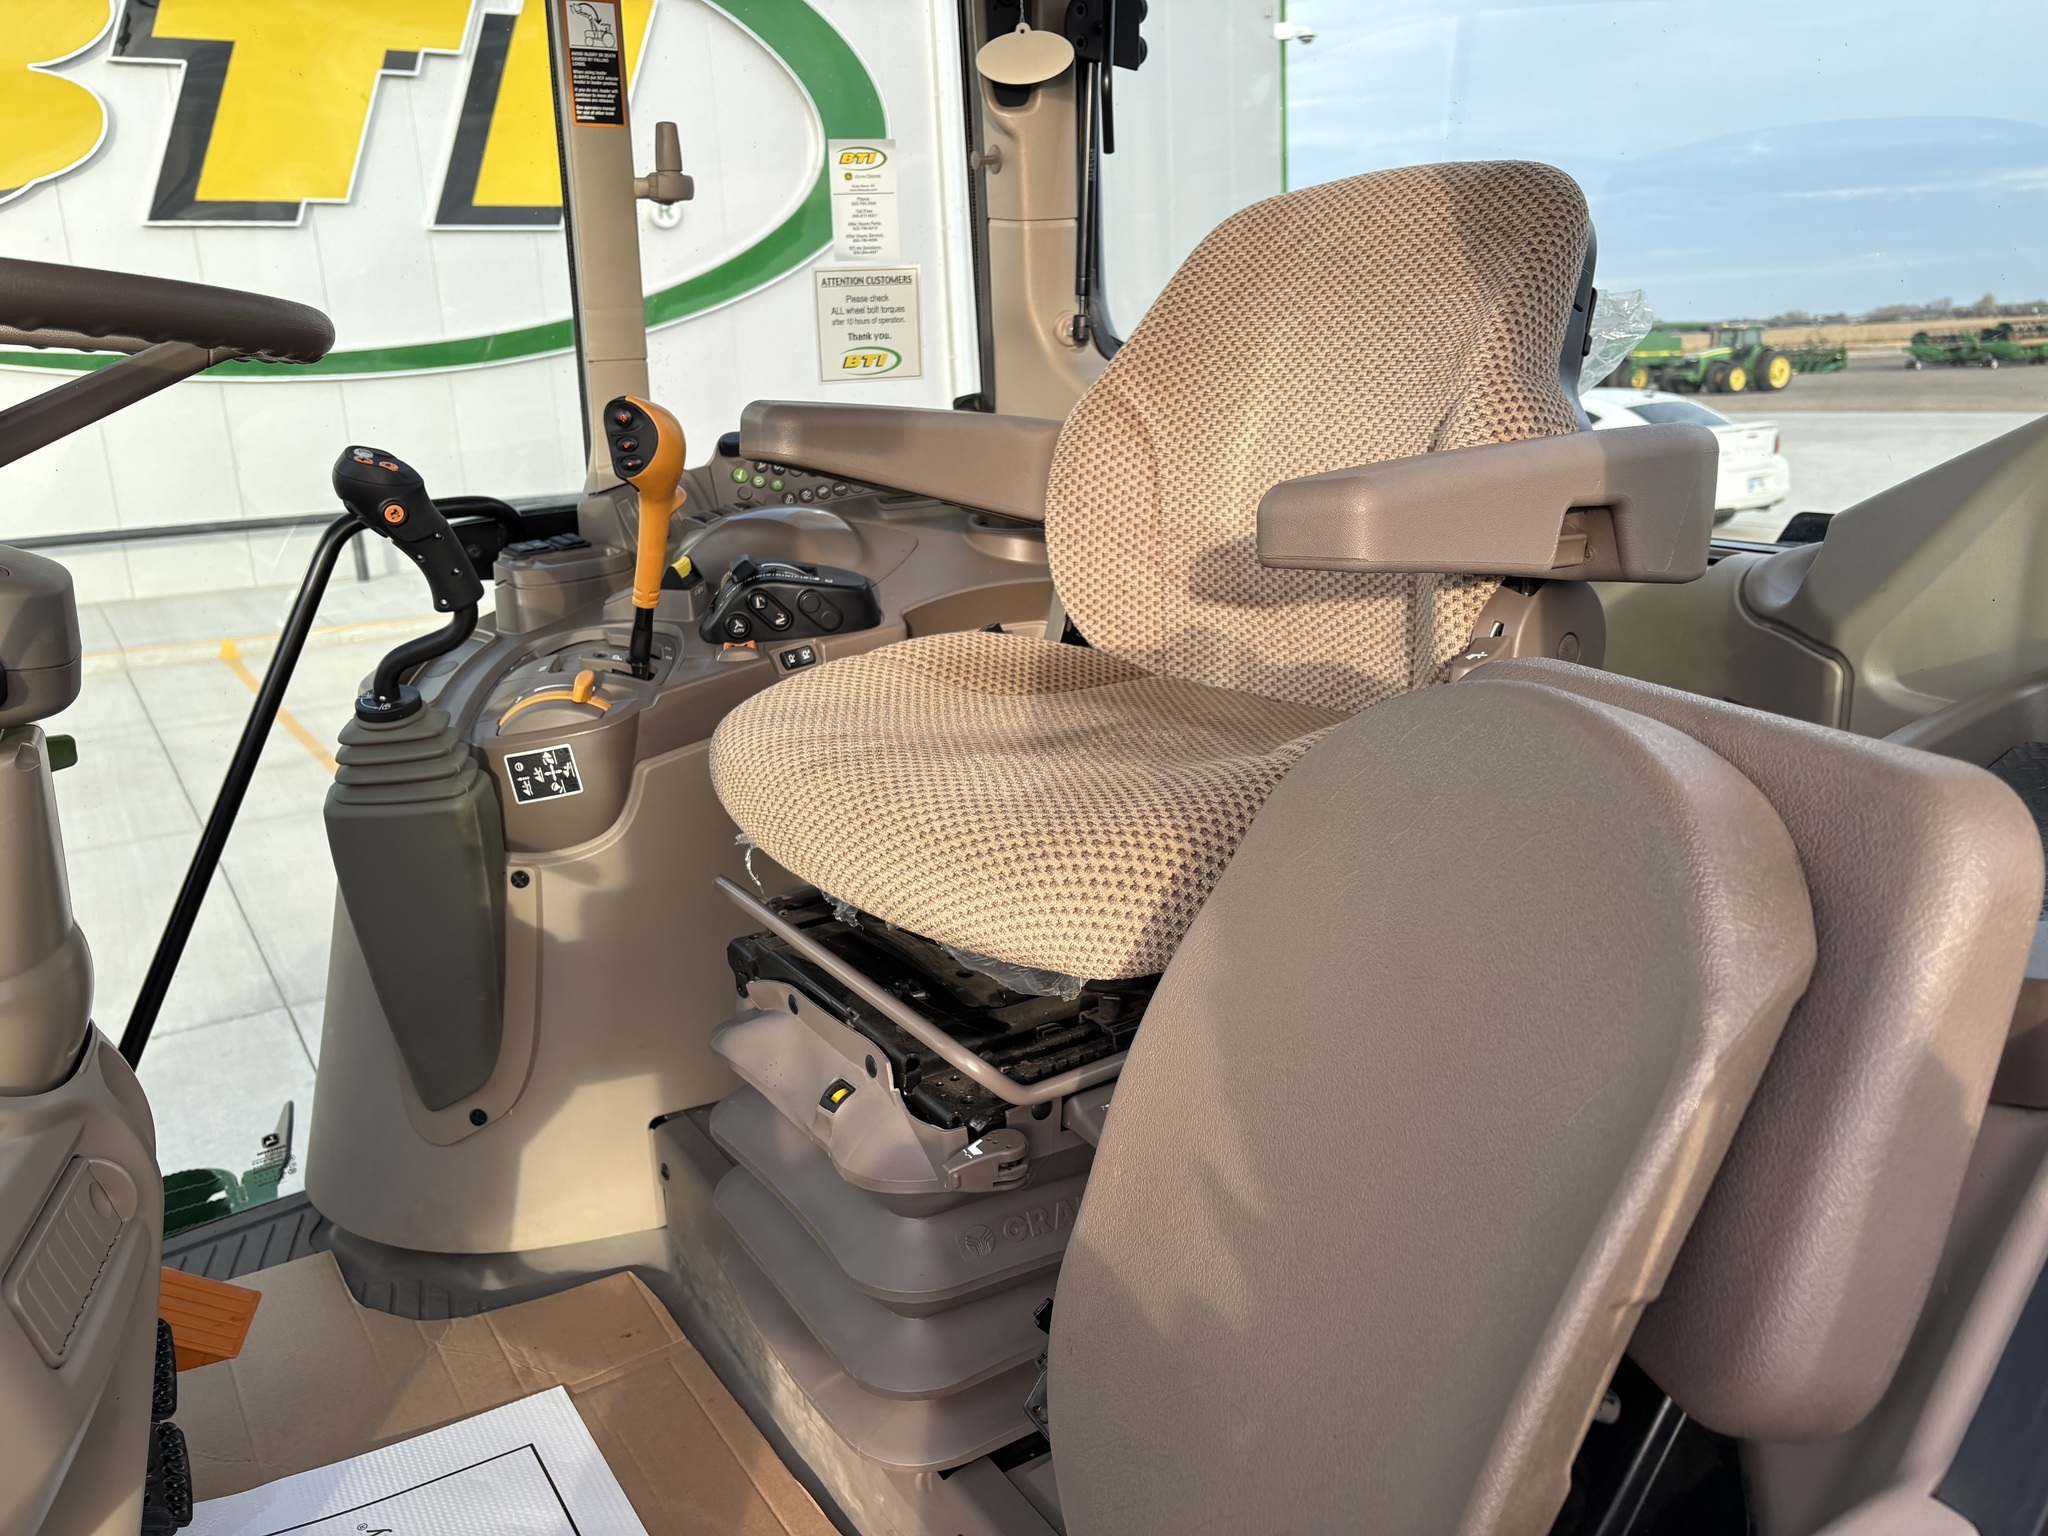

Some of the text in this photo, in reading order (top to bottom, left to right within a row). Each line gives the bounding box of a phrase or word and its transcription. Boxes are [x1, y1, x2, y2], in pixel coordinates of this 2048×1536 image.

[839, 152, 877, 165] BTI
[822, 275, 912, 286] ATTENTION CUSTOMERS
[846, 294, 889, 303] Please check
[831, 306, 905, 315] ALL wheel bolt torques
[848, 332, 892, 341] Thank you.
[842, 353, 889, 369] BTI
